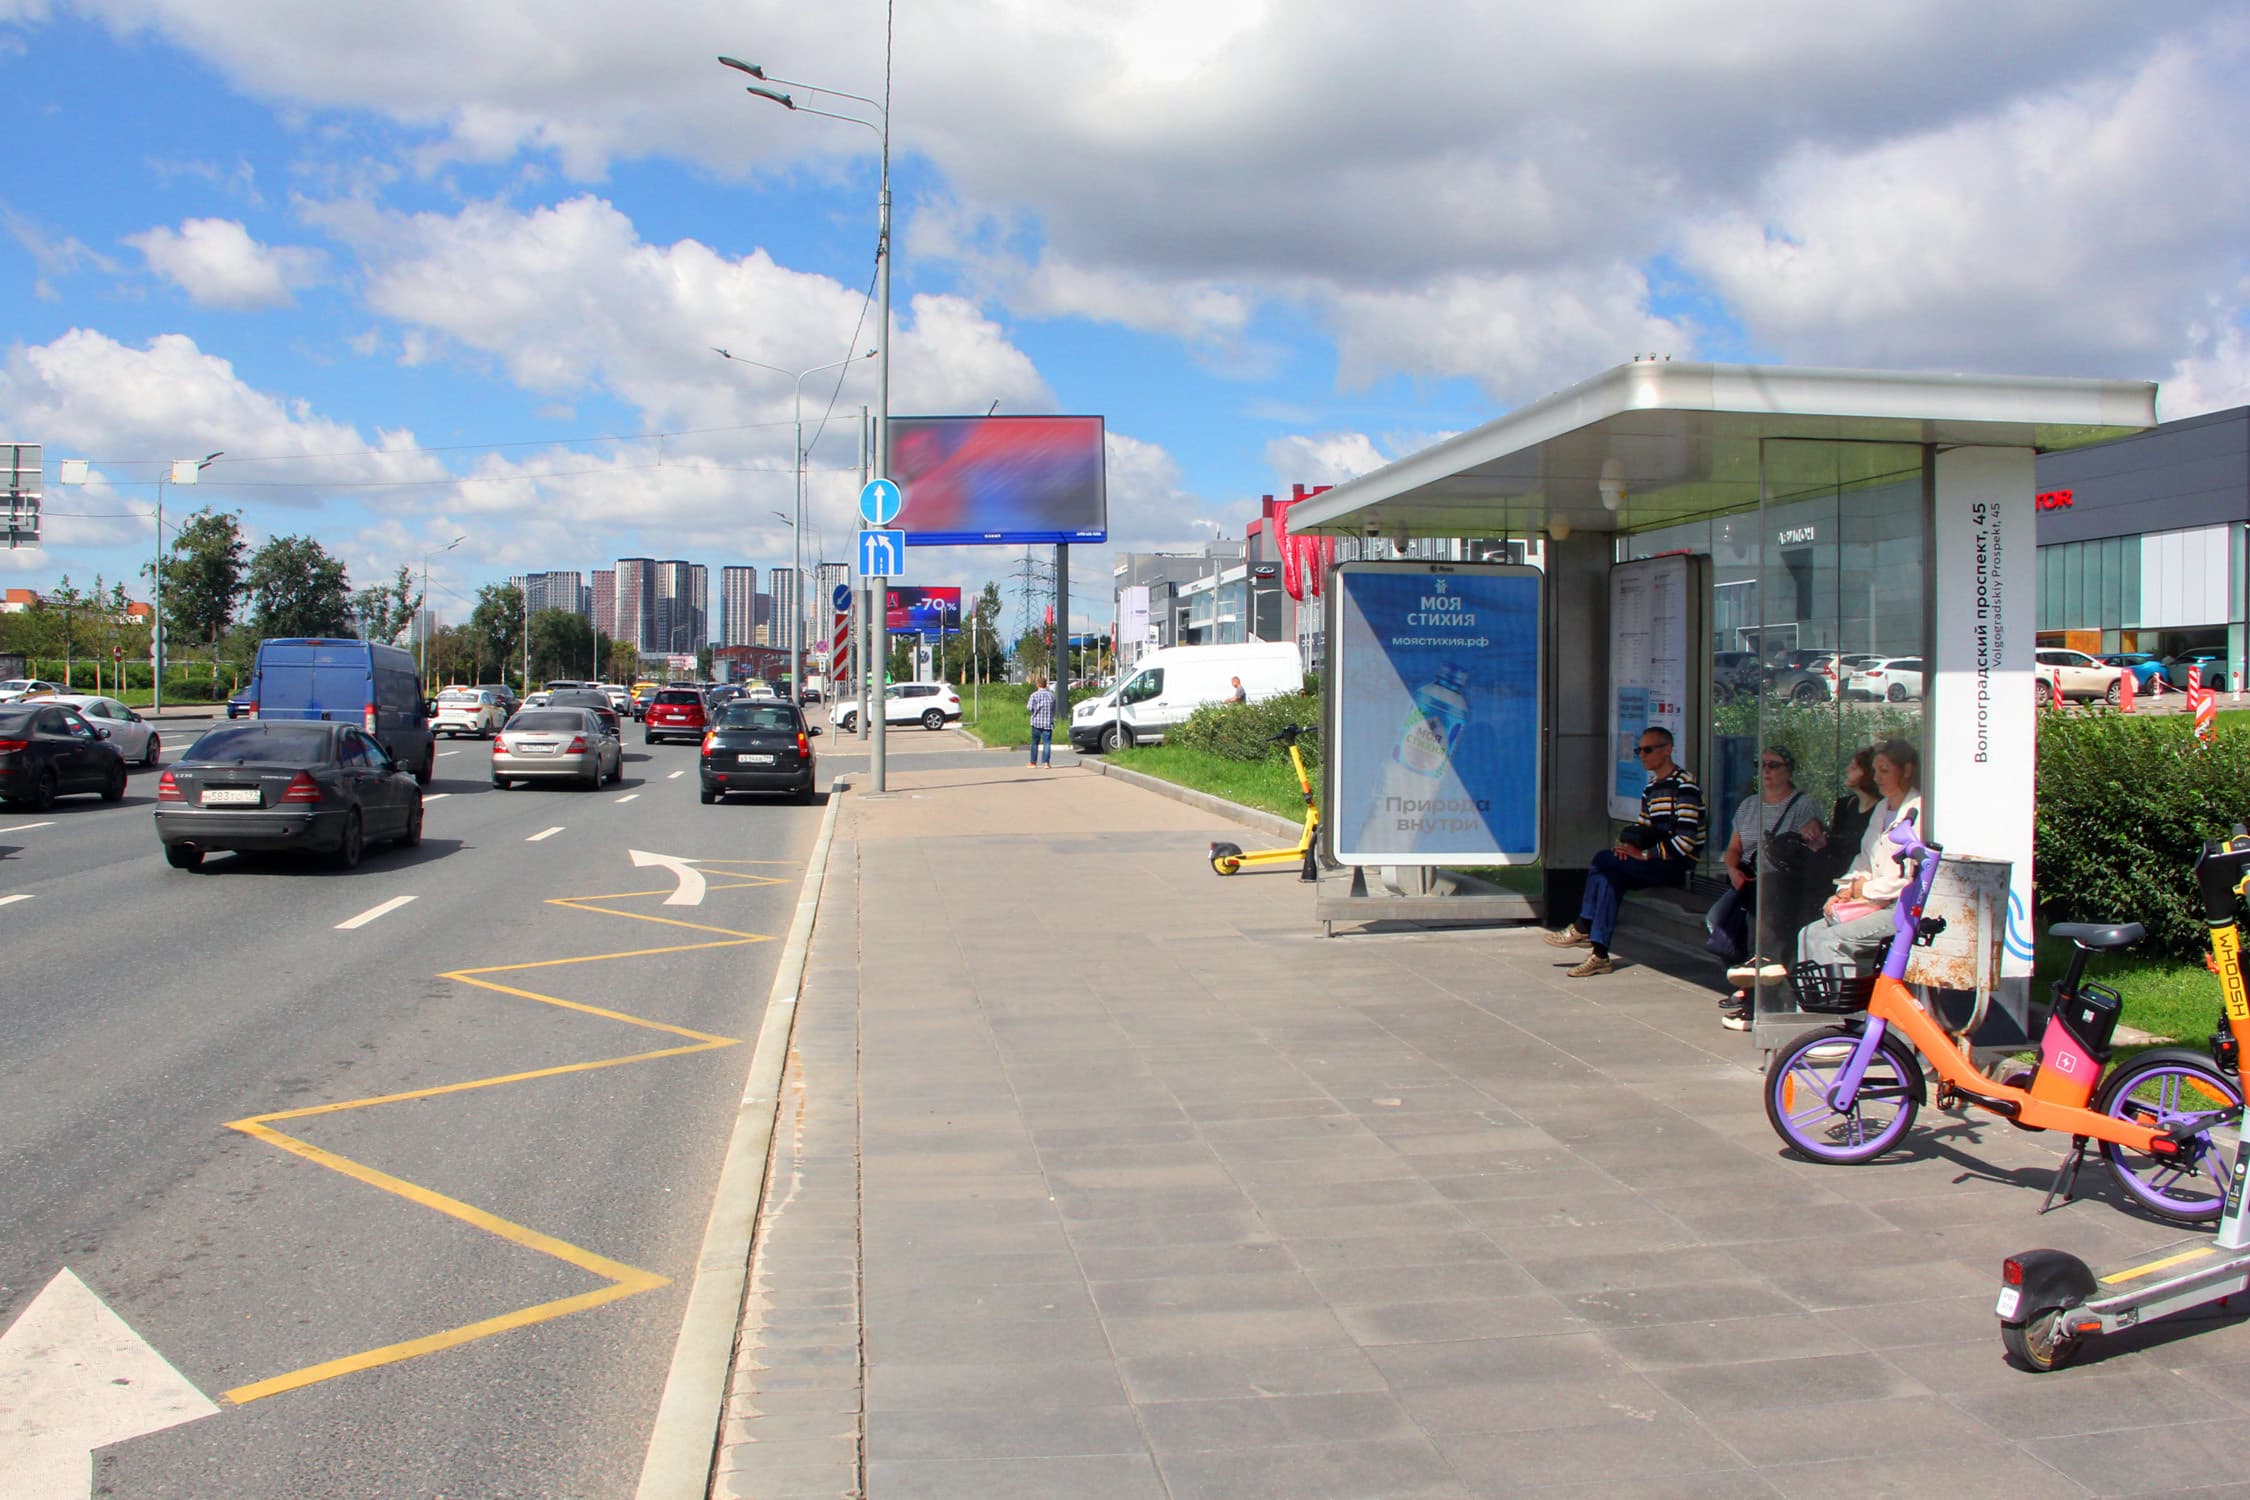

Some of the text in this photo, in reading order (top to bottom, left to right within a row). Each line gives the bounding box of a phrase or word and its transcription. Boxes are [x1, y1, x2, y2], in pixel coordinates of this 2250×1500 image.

[1990, 503, 2003, 667] Volgogradskiy Prospekt, 45
[1420, 596, 1461, 610] МОЯ
[1407, 613, 1475, 626] СТИХИЯ
[1972, 503, 1990, 763] Волгоградский проспект, 45
[1392, 636, 1489, 648] моястихия.рф
[1417, 727, 1442, 744] МОЯ
[1385, 796, 1490, 814] Природа
[1396, 818, 1479, 834] внутри
[2218, 932, 2246, 1017] WHOOSH
